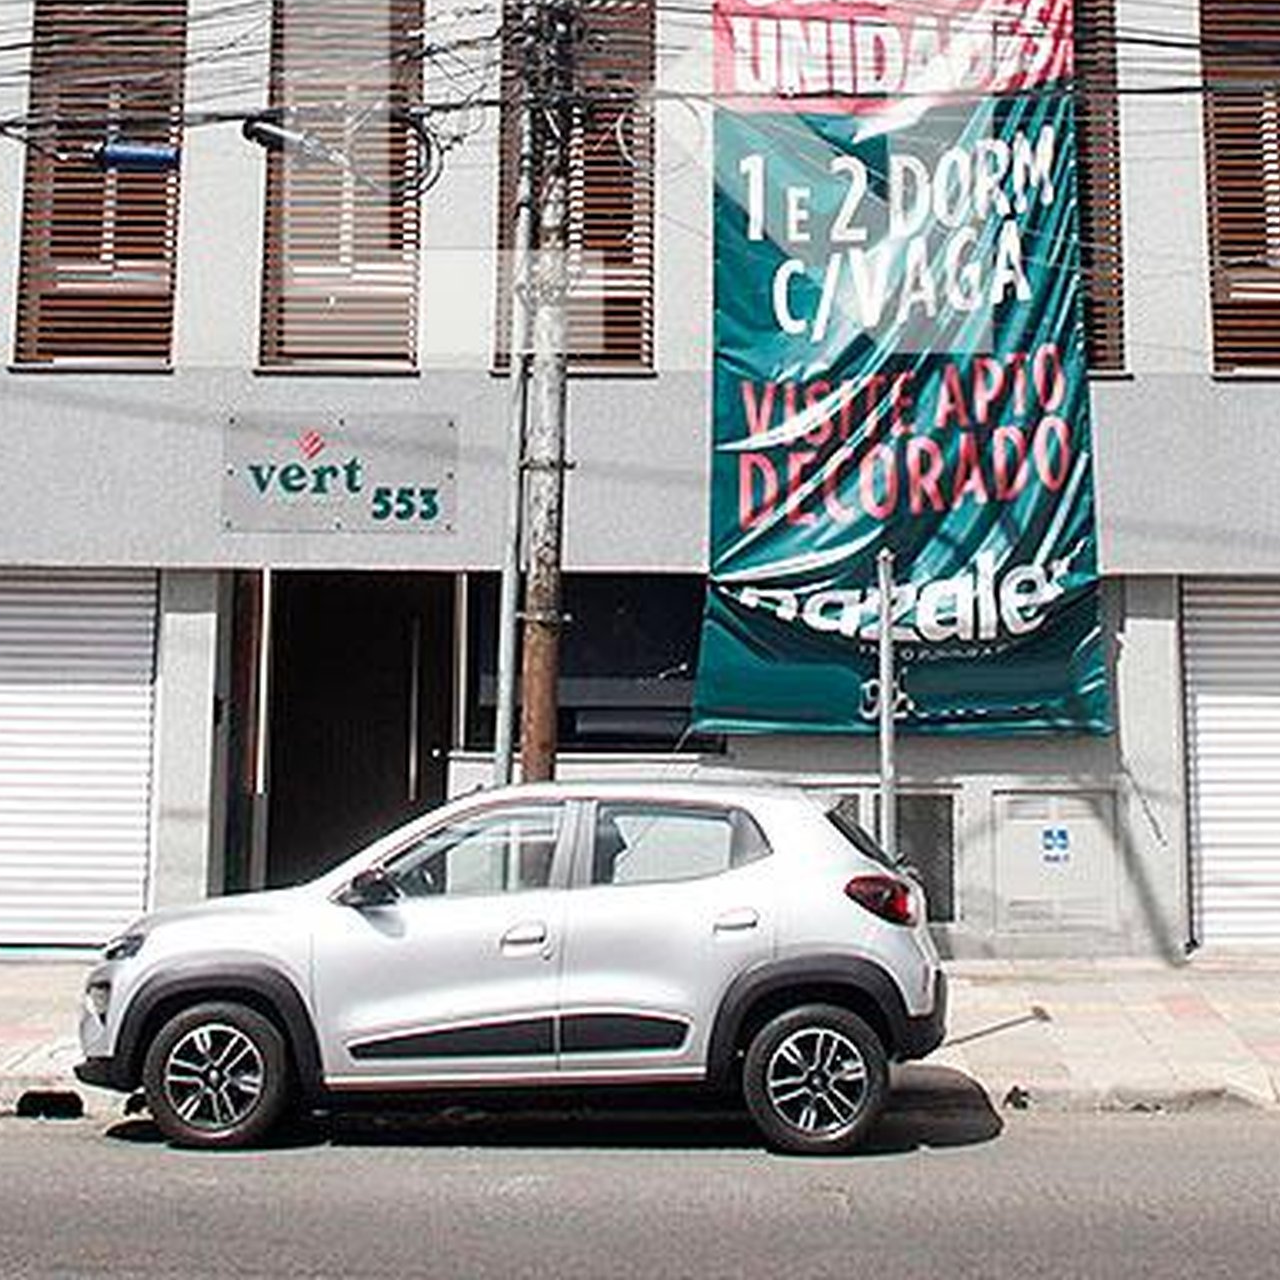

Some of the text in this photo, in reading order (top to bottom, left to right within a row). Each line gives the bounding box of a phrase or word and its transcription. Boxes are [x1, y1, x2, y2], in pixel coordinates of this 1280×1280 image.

[739, 125, 1056, 242] 1 E 2 DORM
[772, 222, 1031, 342] C/VAGA
[738, 343, 1064, 446] VISITE APTO
[248, 456, 439, 521] vert 553
[738, 416, 1072, 529] DECORADO
